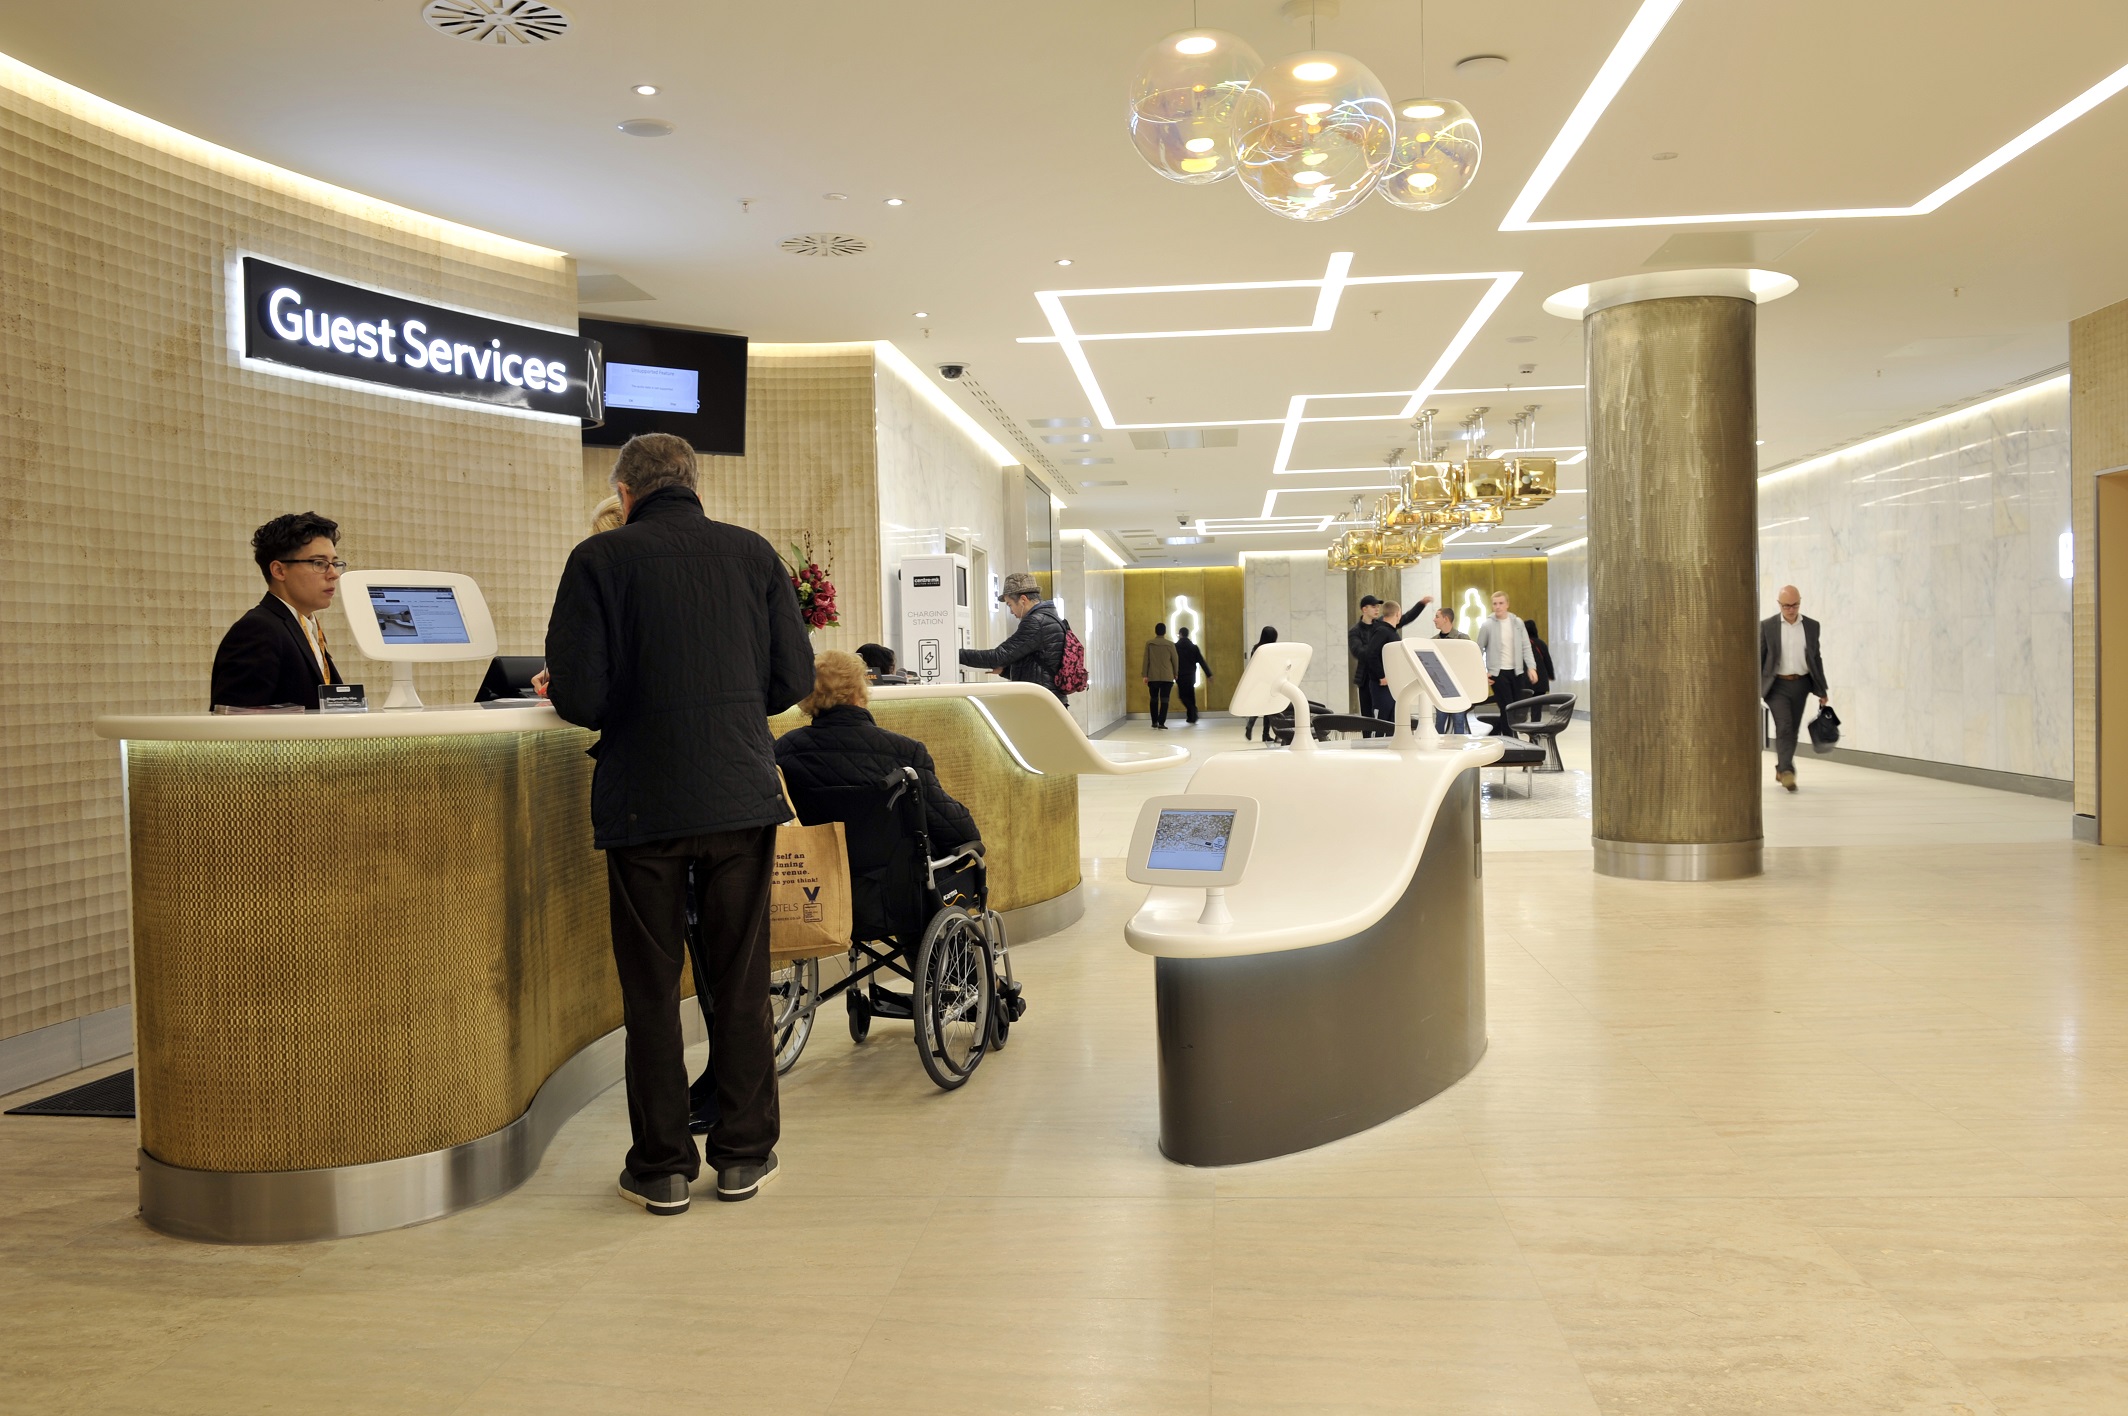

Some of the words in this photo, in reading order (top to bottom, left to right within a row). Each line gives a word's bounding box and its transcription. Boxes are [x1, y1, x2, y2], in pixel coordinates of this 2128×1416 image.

[269, 287, 397, 363] Guest
[403, 319, 568, 394] Services
[907, 610, 949, 618] CHARGING
[912, 618, 944, 626] STATION
